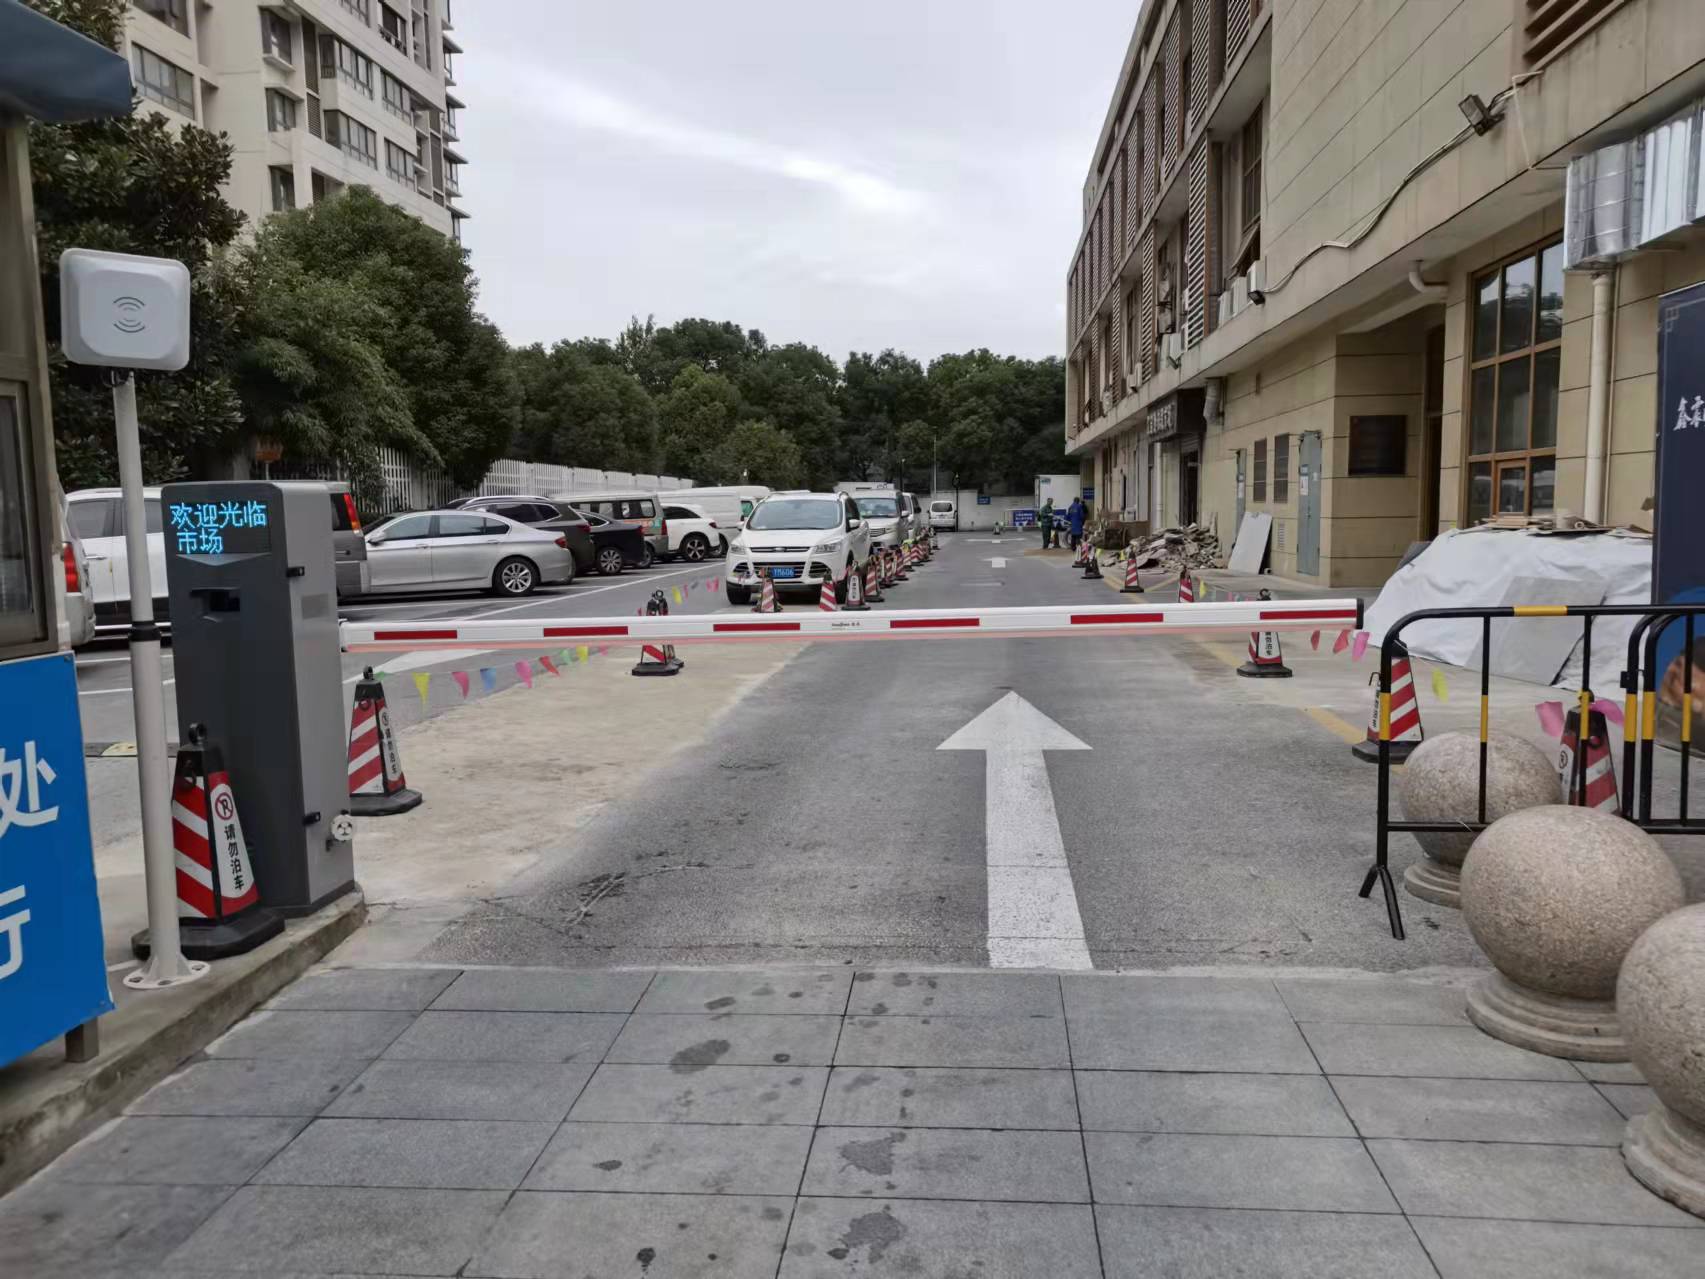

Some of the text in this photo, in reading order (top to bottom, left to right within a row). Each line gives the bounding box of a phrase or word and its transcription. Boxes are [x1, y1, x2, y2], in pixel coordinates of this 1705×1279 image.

[169, 500, 268, 530] 欢迎光临
[175, 527, 224, 555] 市场
[223, 823, 245, 892] 请勿泊车
